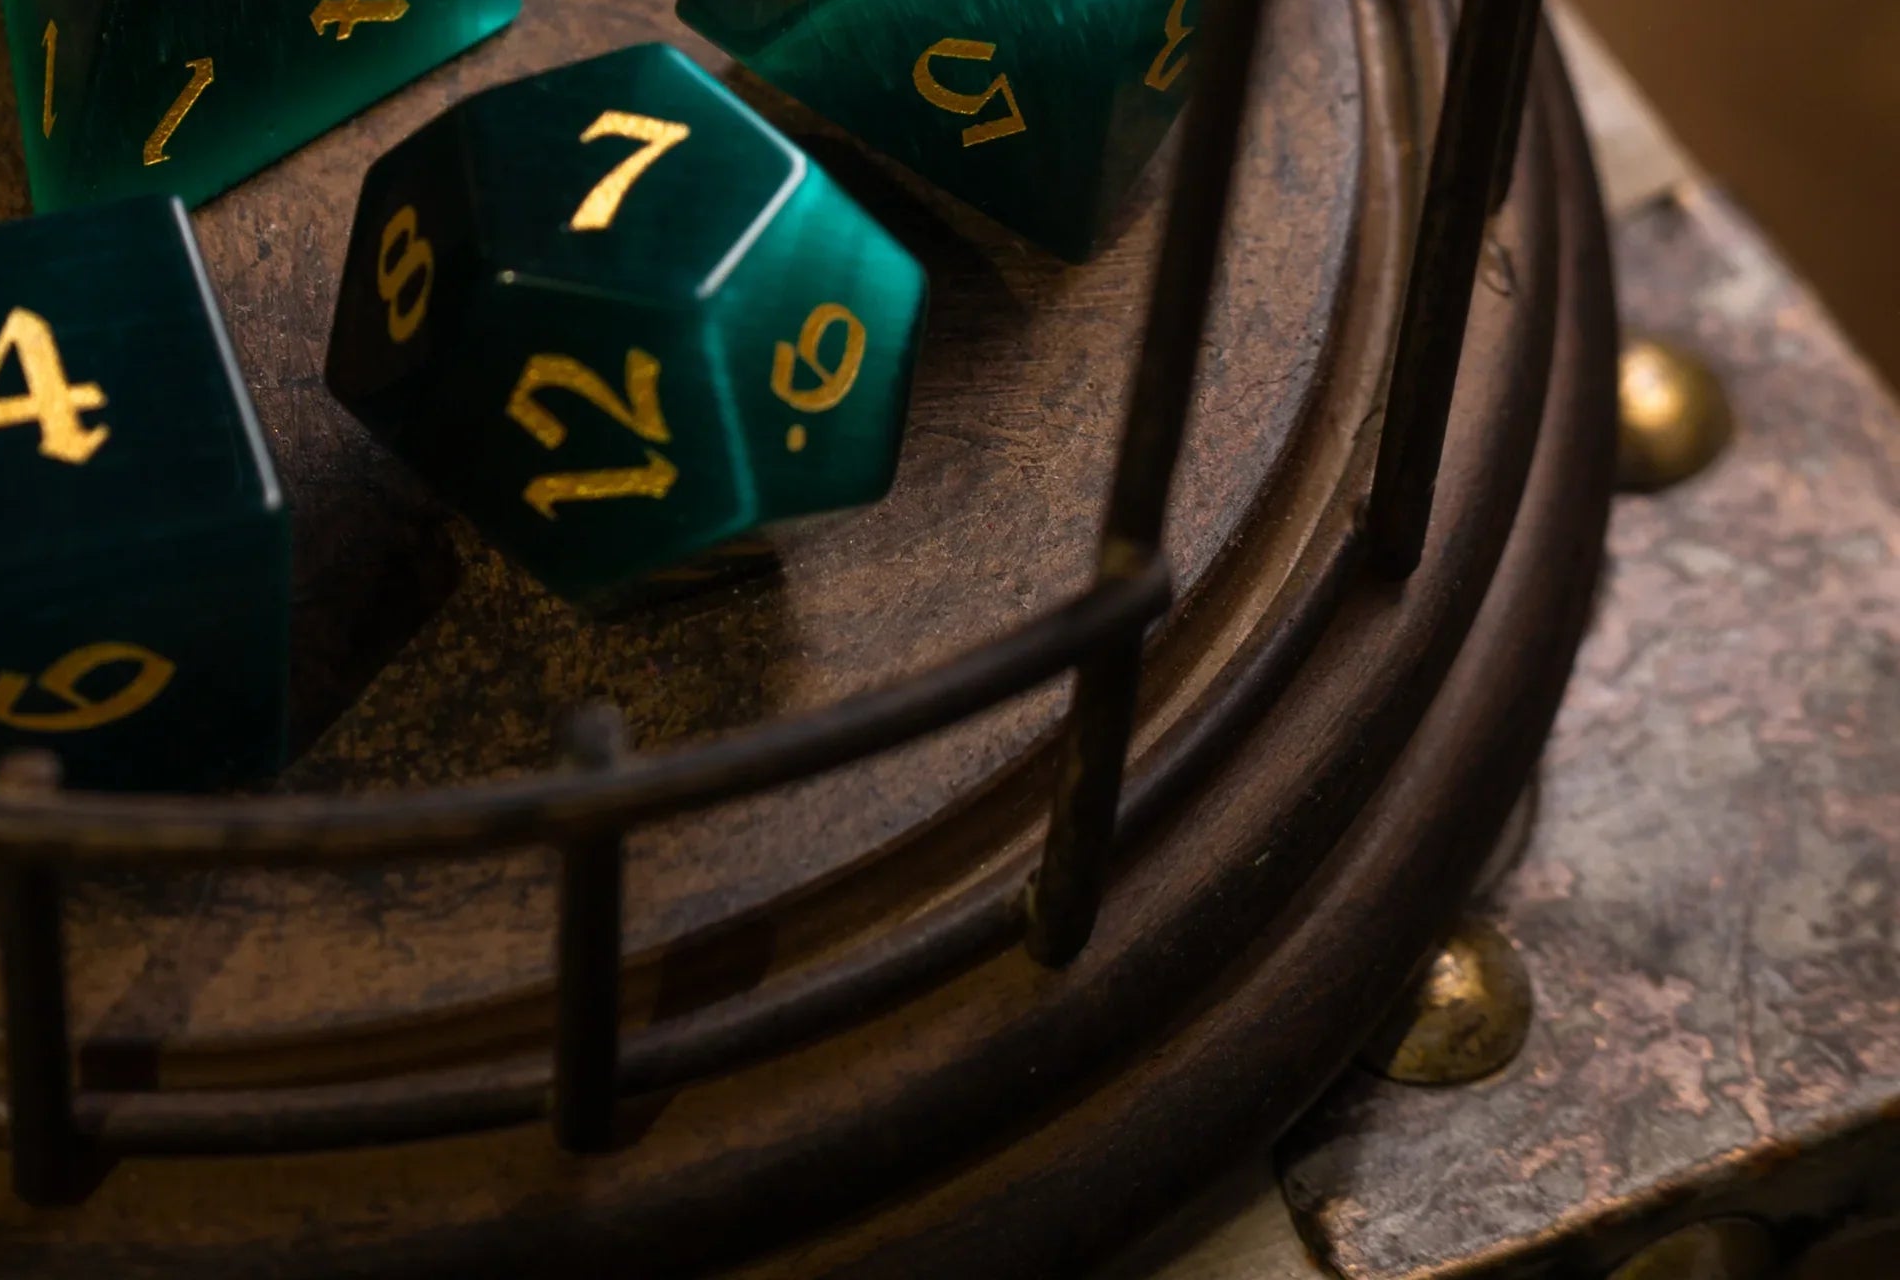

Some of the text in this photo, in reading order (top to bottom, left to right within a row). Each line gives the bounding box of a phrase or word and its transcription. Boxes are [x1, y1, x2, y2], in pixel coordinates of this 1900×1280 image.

[41, 18, 59, 139] 1
[142, 56, 216, 167] 1
[911, 36, 1028, 148] 5
[576, 109, 691, 231] 7
[376, 204, 436, 343] 8
[505, 348, 678, 518] 12
